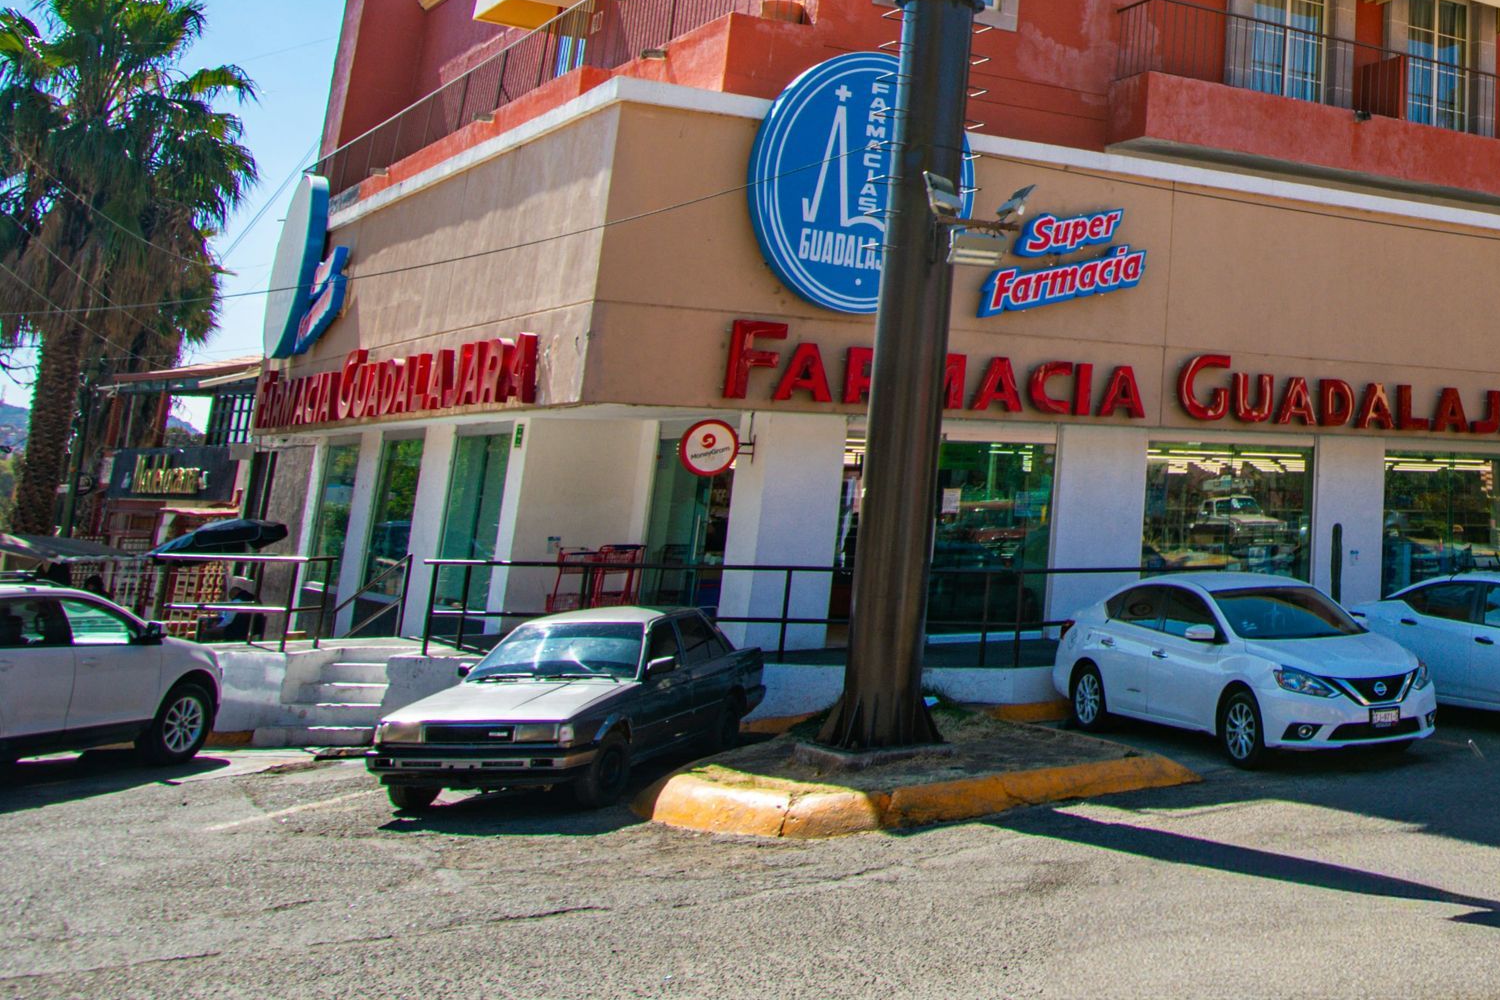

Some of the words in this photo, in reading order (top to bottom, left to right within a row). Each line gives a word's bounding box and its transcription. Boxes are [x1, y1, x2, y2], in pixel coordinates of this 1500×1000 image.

[799, 228, 882, 271] GUADALA
[1026, 210, 1122, 252] Super
[989, 246, 1145, 310] Farmacia
[338, 332, 539, 420] GUADALAJARA
[691, 446, 731, 460] MoneyGram
